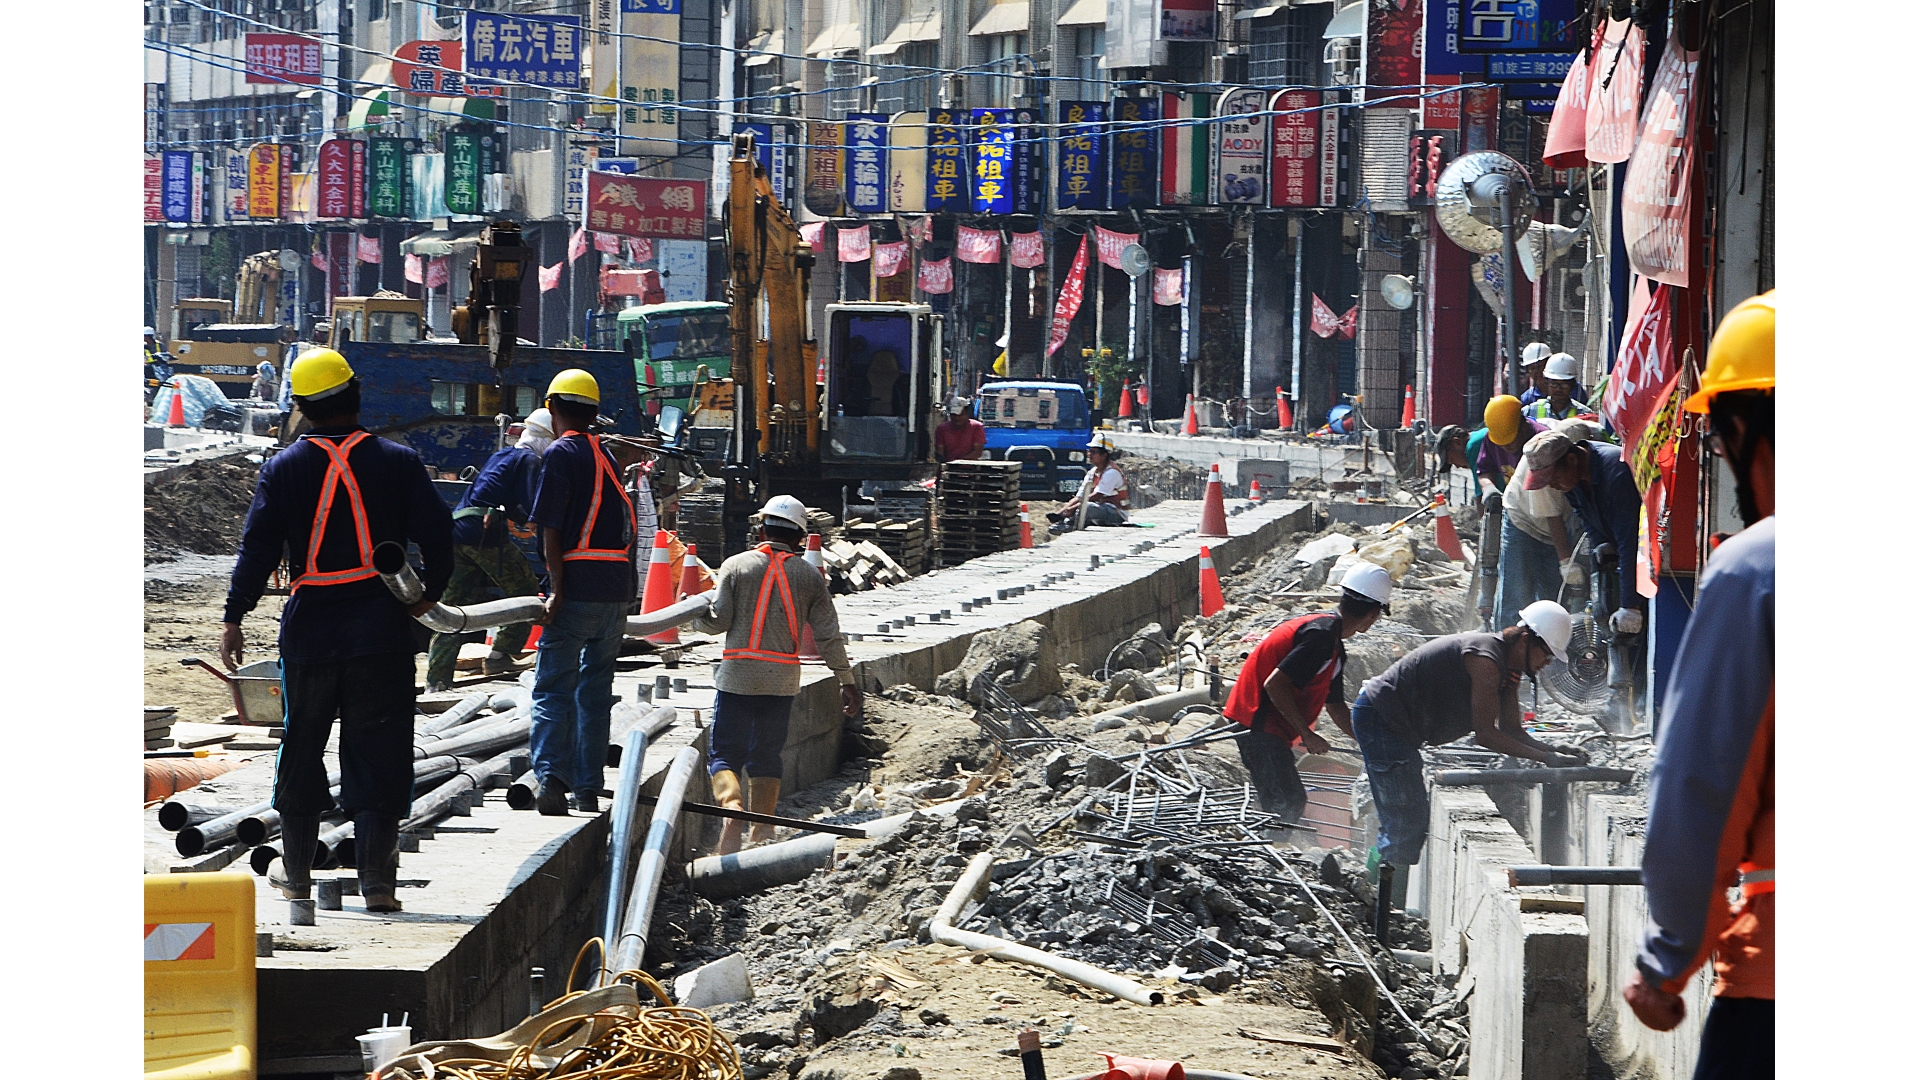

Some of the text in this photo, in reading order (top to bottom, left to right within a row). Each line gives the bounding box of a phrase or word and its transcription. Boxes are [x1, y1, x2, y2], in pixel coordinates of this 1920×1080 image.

[247, 43, 320, 75] 旺旺租車
[472, 18, 575, 65] 僑宏汽車
[975, 111, 1005, 204] 良祐租車
[1223, 138, 1263, 151] AODY
[324, 143, 347, 215] 久大五金行
